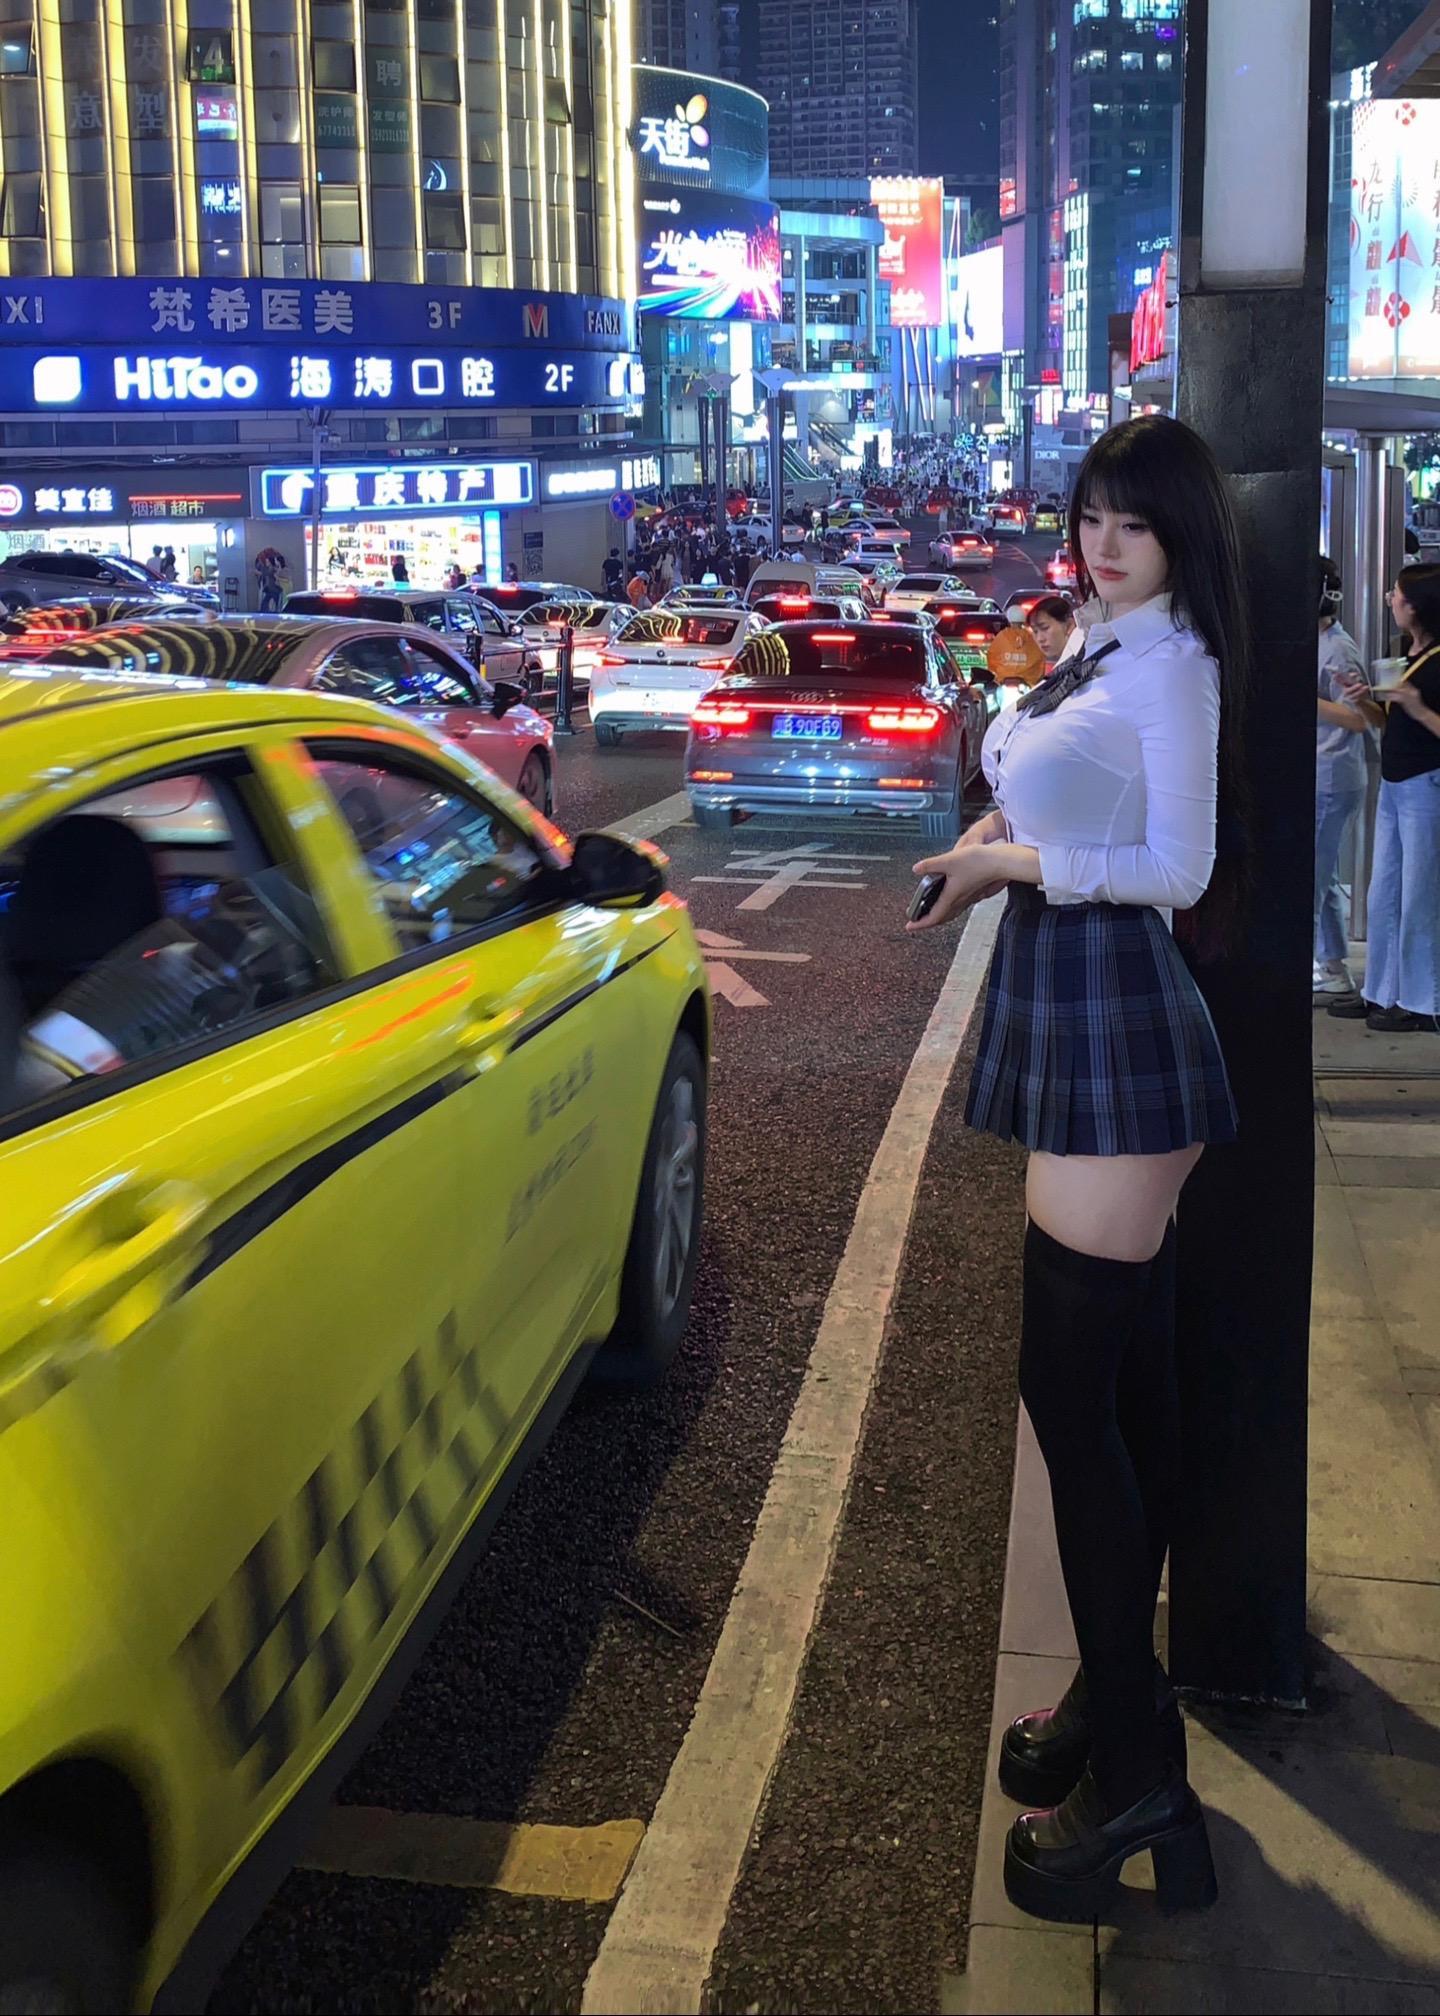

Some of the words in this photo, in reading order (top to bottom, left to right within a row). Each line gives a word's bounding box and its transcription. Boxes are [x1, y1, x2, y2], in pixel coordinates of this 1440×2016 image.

[639, 116, 691, 159] 天街
[149, 286, 354, 333] 梵希医美
[113, 355, 259, 401] HiTao
[289, 355, 496, 399] 海涛口腔
[544, 363, 575, 393] 2F
[1034, 450, 1060, 460] DIOR
[34, 487, 114, 513] 美宜佳
[325, 468, 486, 508] 重庆特产
